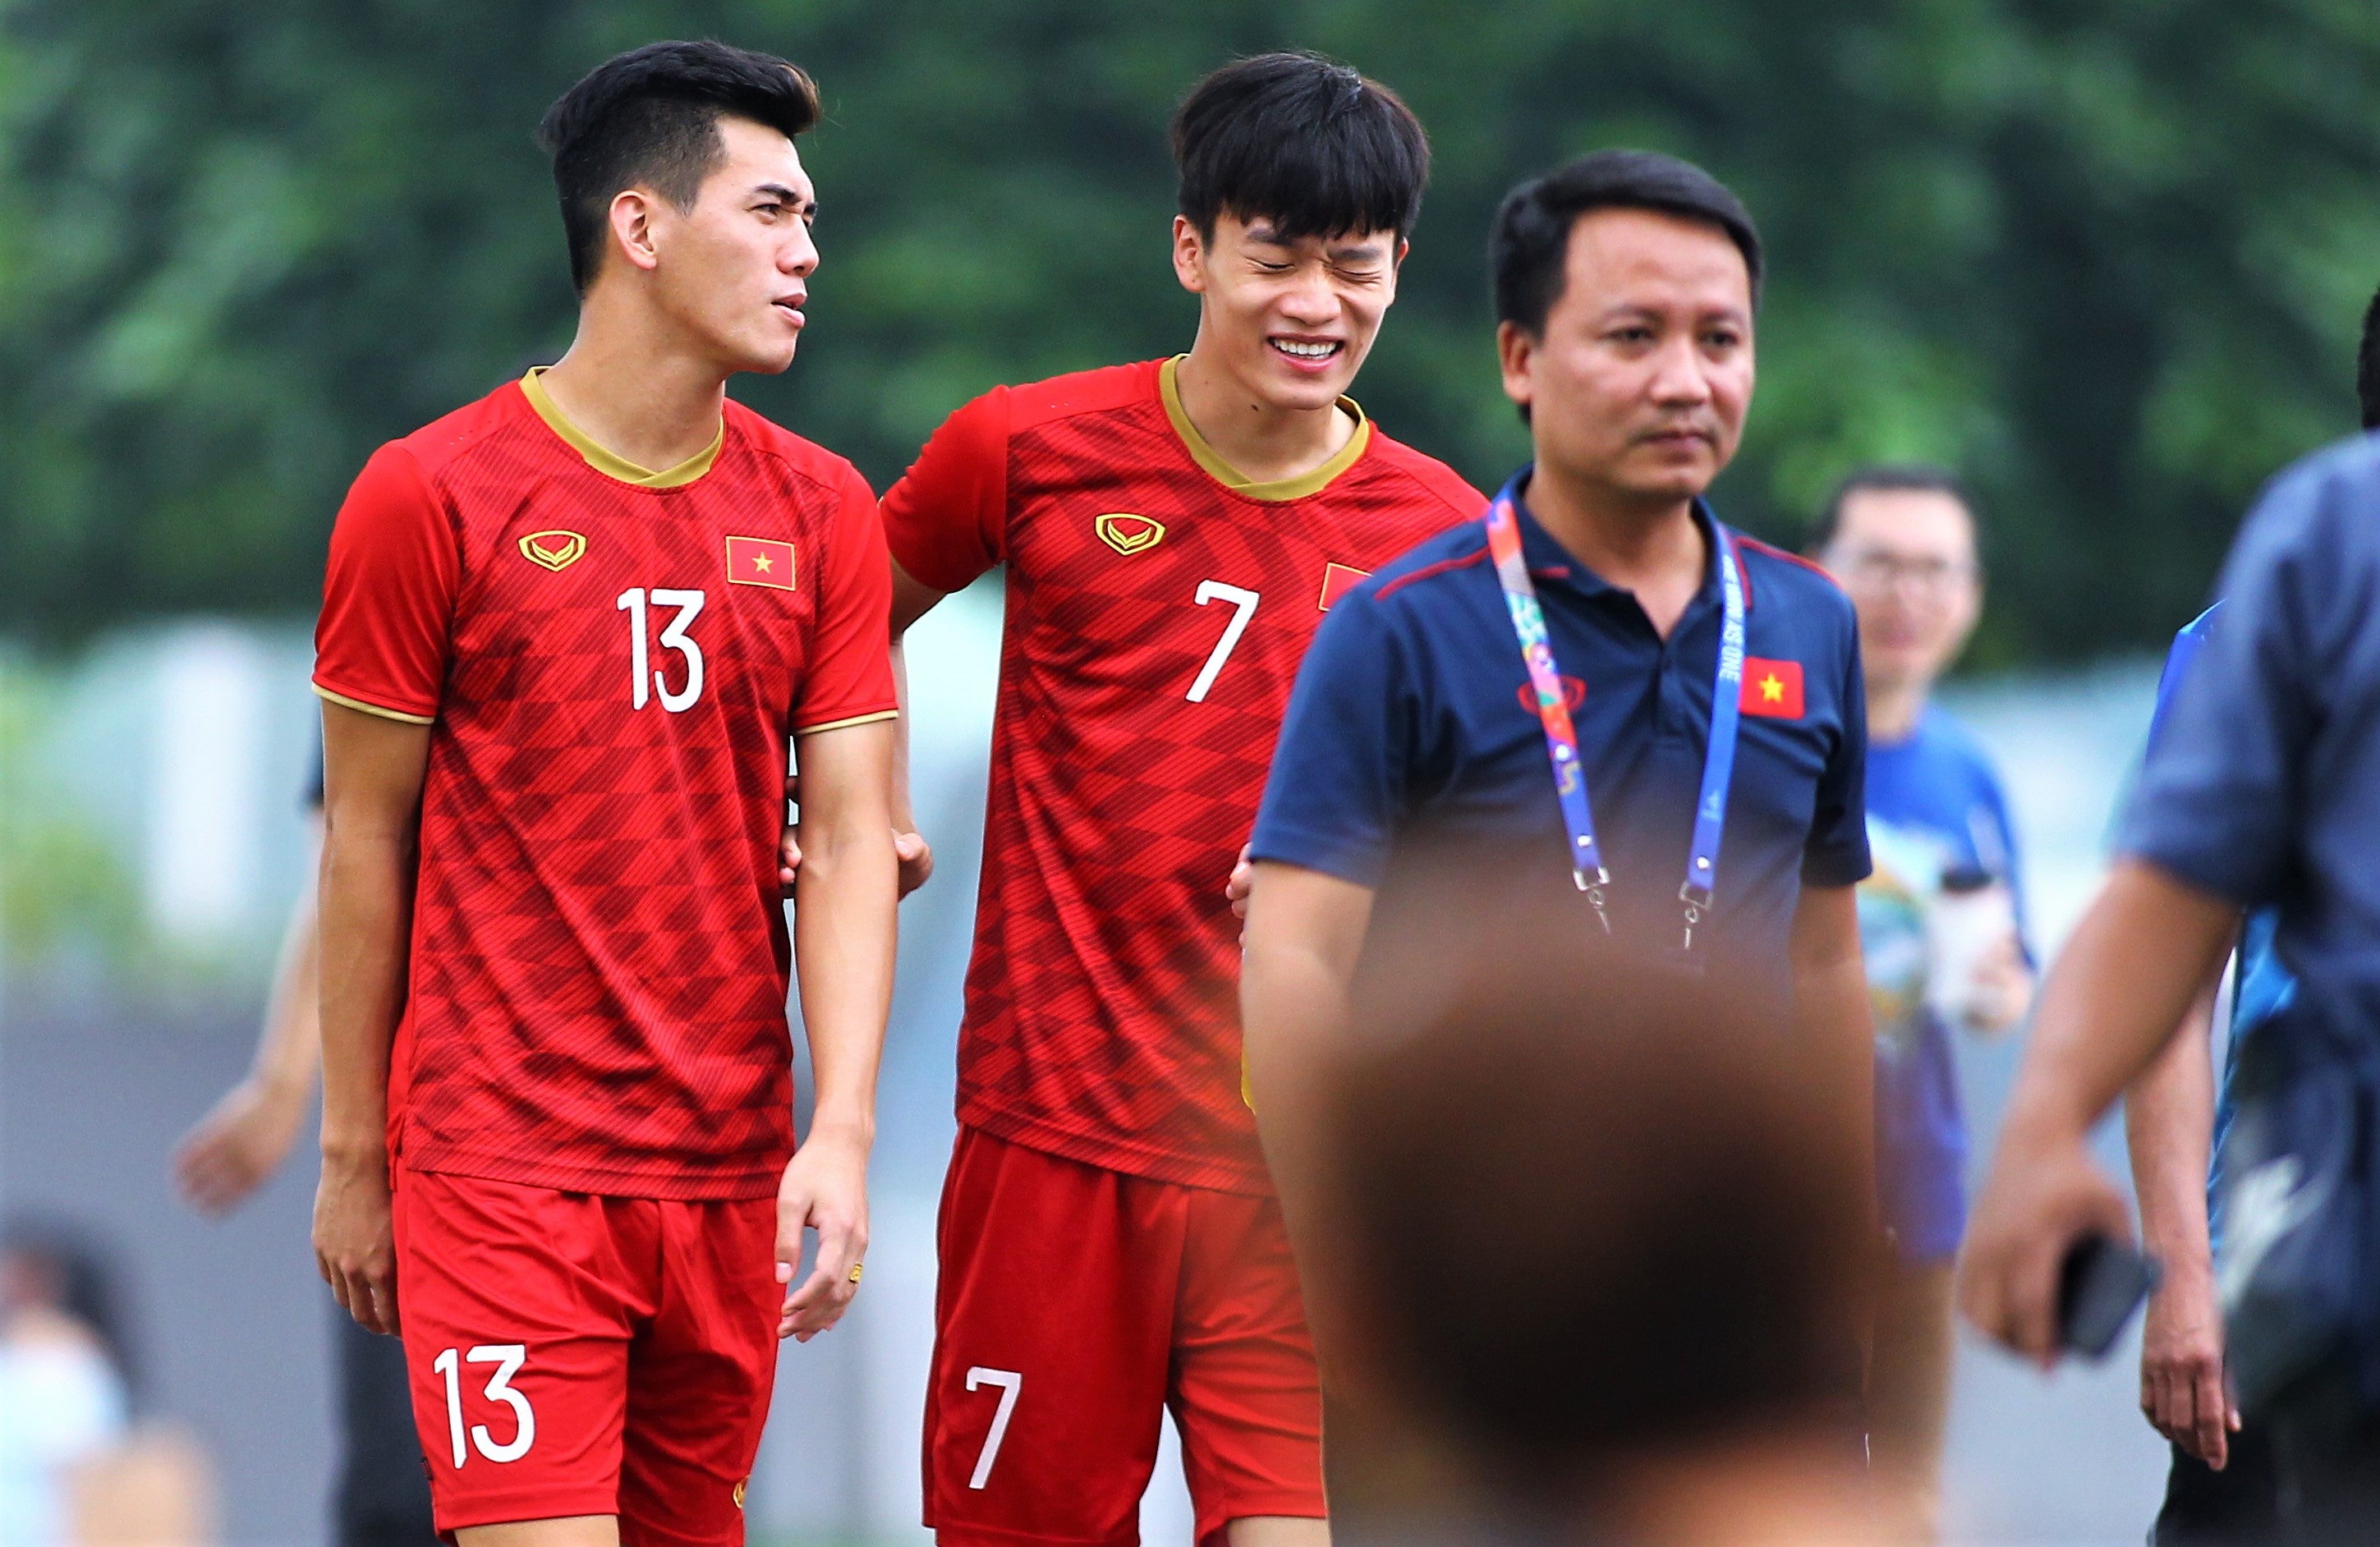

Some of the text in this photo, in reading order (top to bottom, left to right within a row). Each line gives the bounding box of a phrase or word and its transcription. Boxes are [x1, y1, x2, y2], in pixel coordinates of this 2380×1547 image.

[617, 588, 705, 713] 13
[1186, 580, 1260, 703] 7
[1719, 645, 1742, 683] ONE
[434, 1344, 535, 1469] 13
[966, 1366, 1022, 1490] 7
